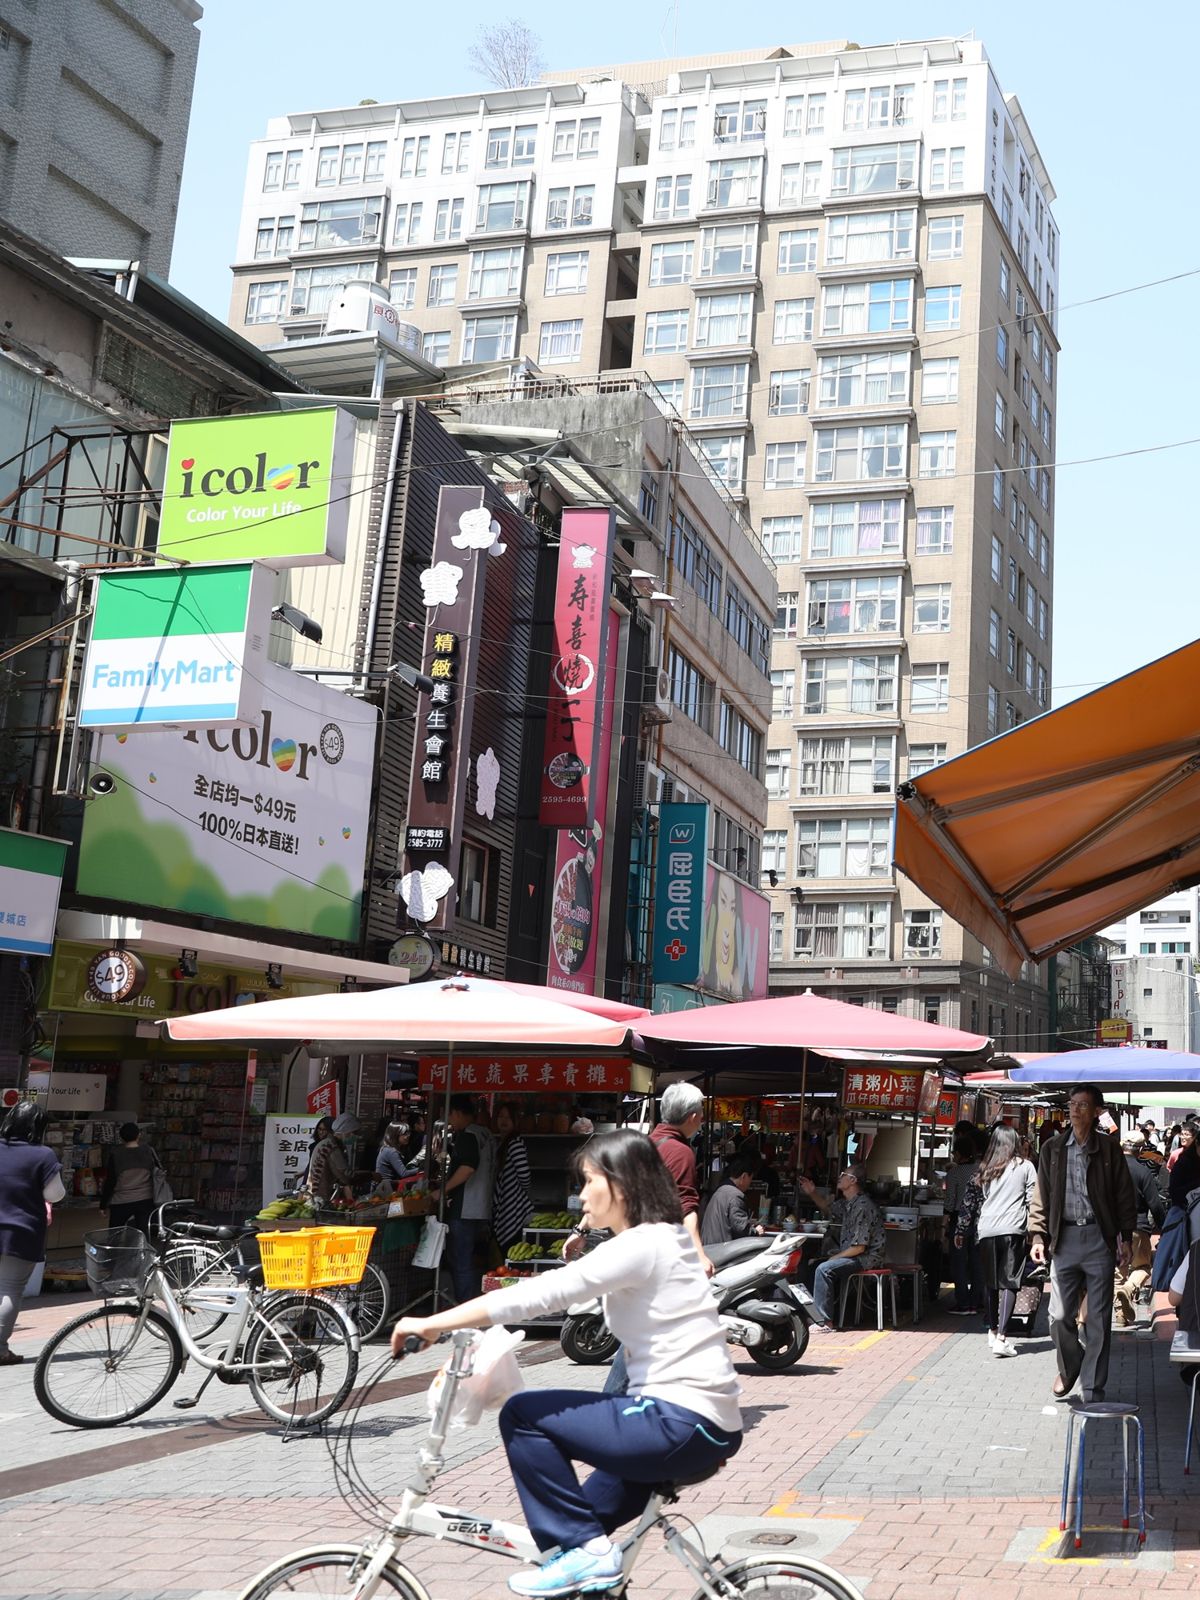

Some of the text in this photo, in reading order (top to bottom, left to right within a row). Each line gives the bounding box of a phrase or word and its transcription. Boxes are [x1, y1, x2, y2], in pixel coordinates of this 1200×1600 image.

[186, 501, 302, 523] Color Your Life
[92, 659, 236, 692] FamilyMart
[421, 633, 455, 781] 精緻養生會館
[193, 774, 297, 823] 全店均一$49元
[199, 811, 299, 855] 100%日本直送!
[407, 838, 443, 848] 2585-3777
[666, 852, 693, 931] 屈臣氏
[95, 963, 126, 986] $49
[848, 1073, 916, 1093] 清粥小菜
[278, 1140, 309, 1153] 全店
[447, 1521, 493, 1535] GEAR
